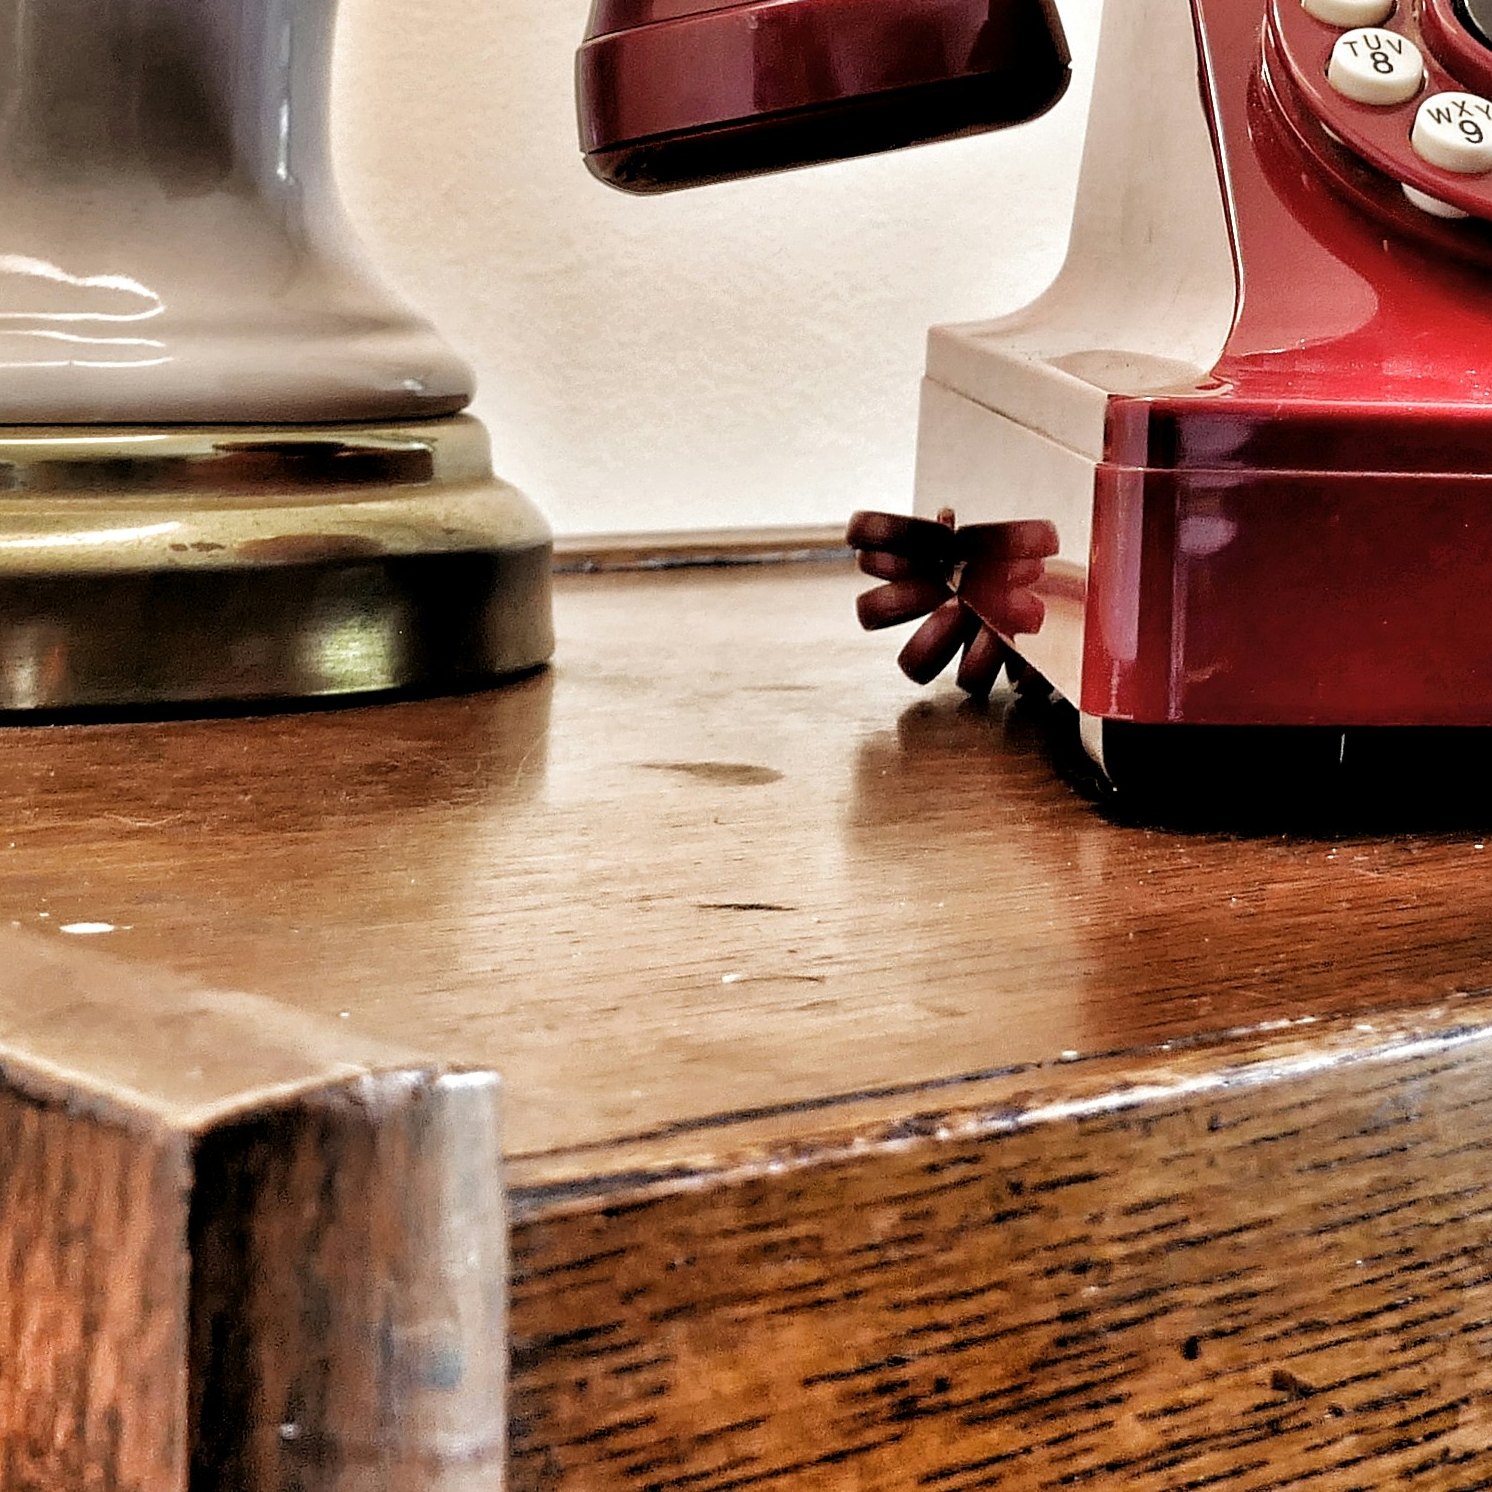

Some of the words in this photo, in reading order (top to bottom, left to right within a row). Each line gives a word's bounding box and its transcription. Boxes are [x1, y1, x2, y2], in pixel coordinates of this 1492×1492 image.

[1343, 34, 1402, 57] TUV
[1369, 51, 1394, 74] 8
[1427, 100, 1492, 125] WXY
[1458, 119, 1484, 144] 9
